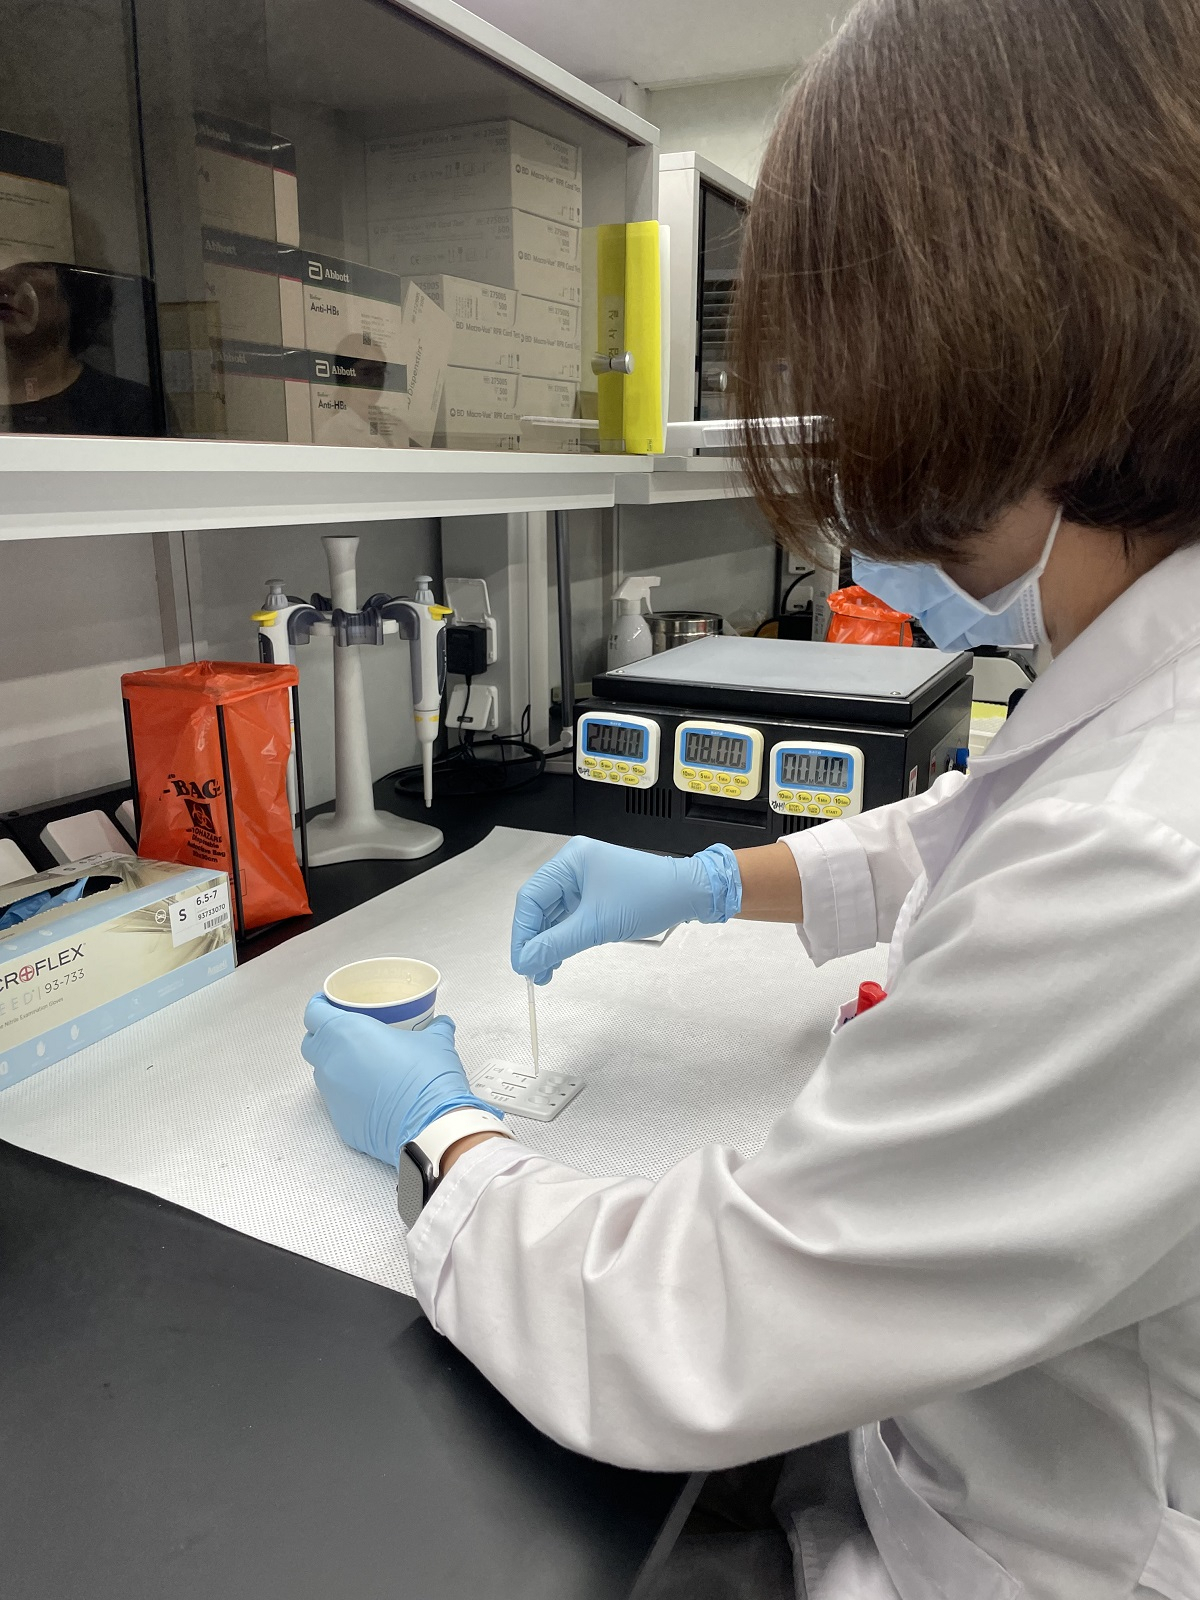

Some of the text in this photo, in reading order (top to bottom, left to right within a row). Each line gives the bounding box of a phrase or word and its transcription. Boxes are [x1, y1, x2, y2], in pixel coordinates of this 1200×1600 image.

[324, 268, 350, 283] Abbott
[310, 302, 340, 317] Anti-HBs
[455, 321, 464, 330] BD
[331, 366, 357, 377] Abbott
[317, 399, 347, 411] Anti-HBs
[196, 889, 218, 906] 6.5-7
[178, 908, 187, 922] S
[197, 903, 226, 921] 93733070
[44, 967, 85, 994] 93-733
[19, 1004, 48, 1021] Examination
[48, 997, 64, 1006] Gloves
